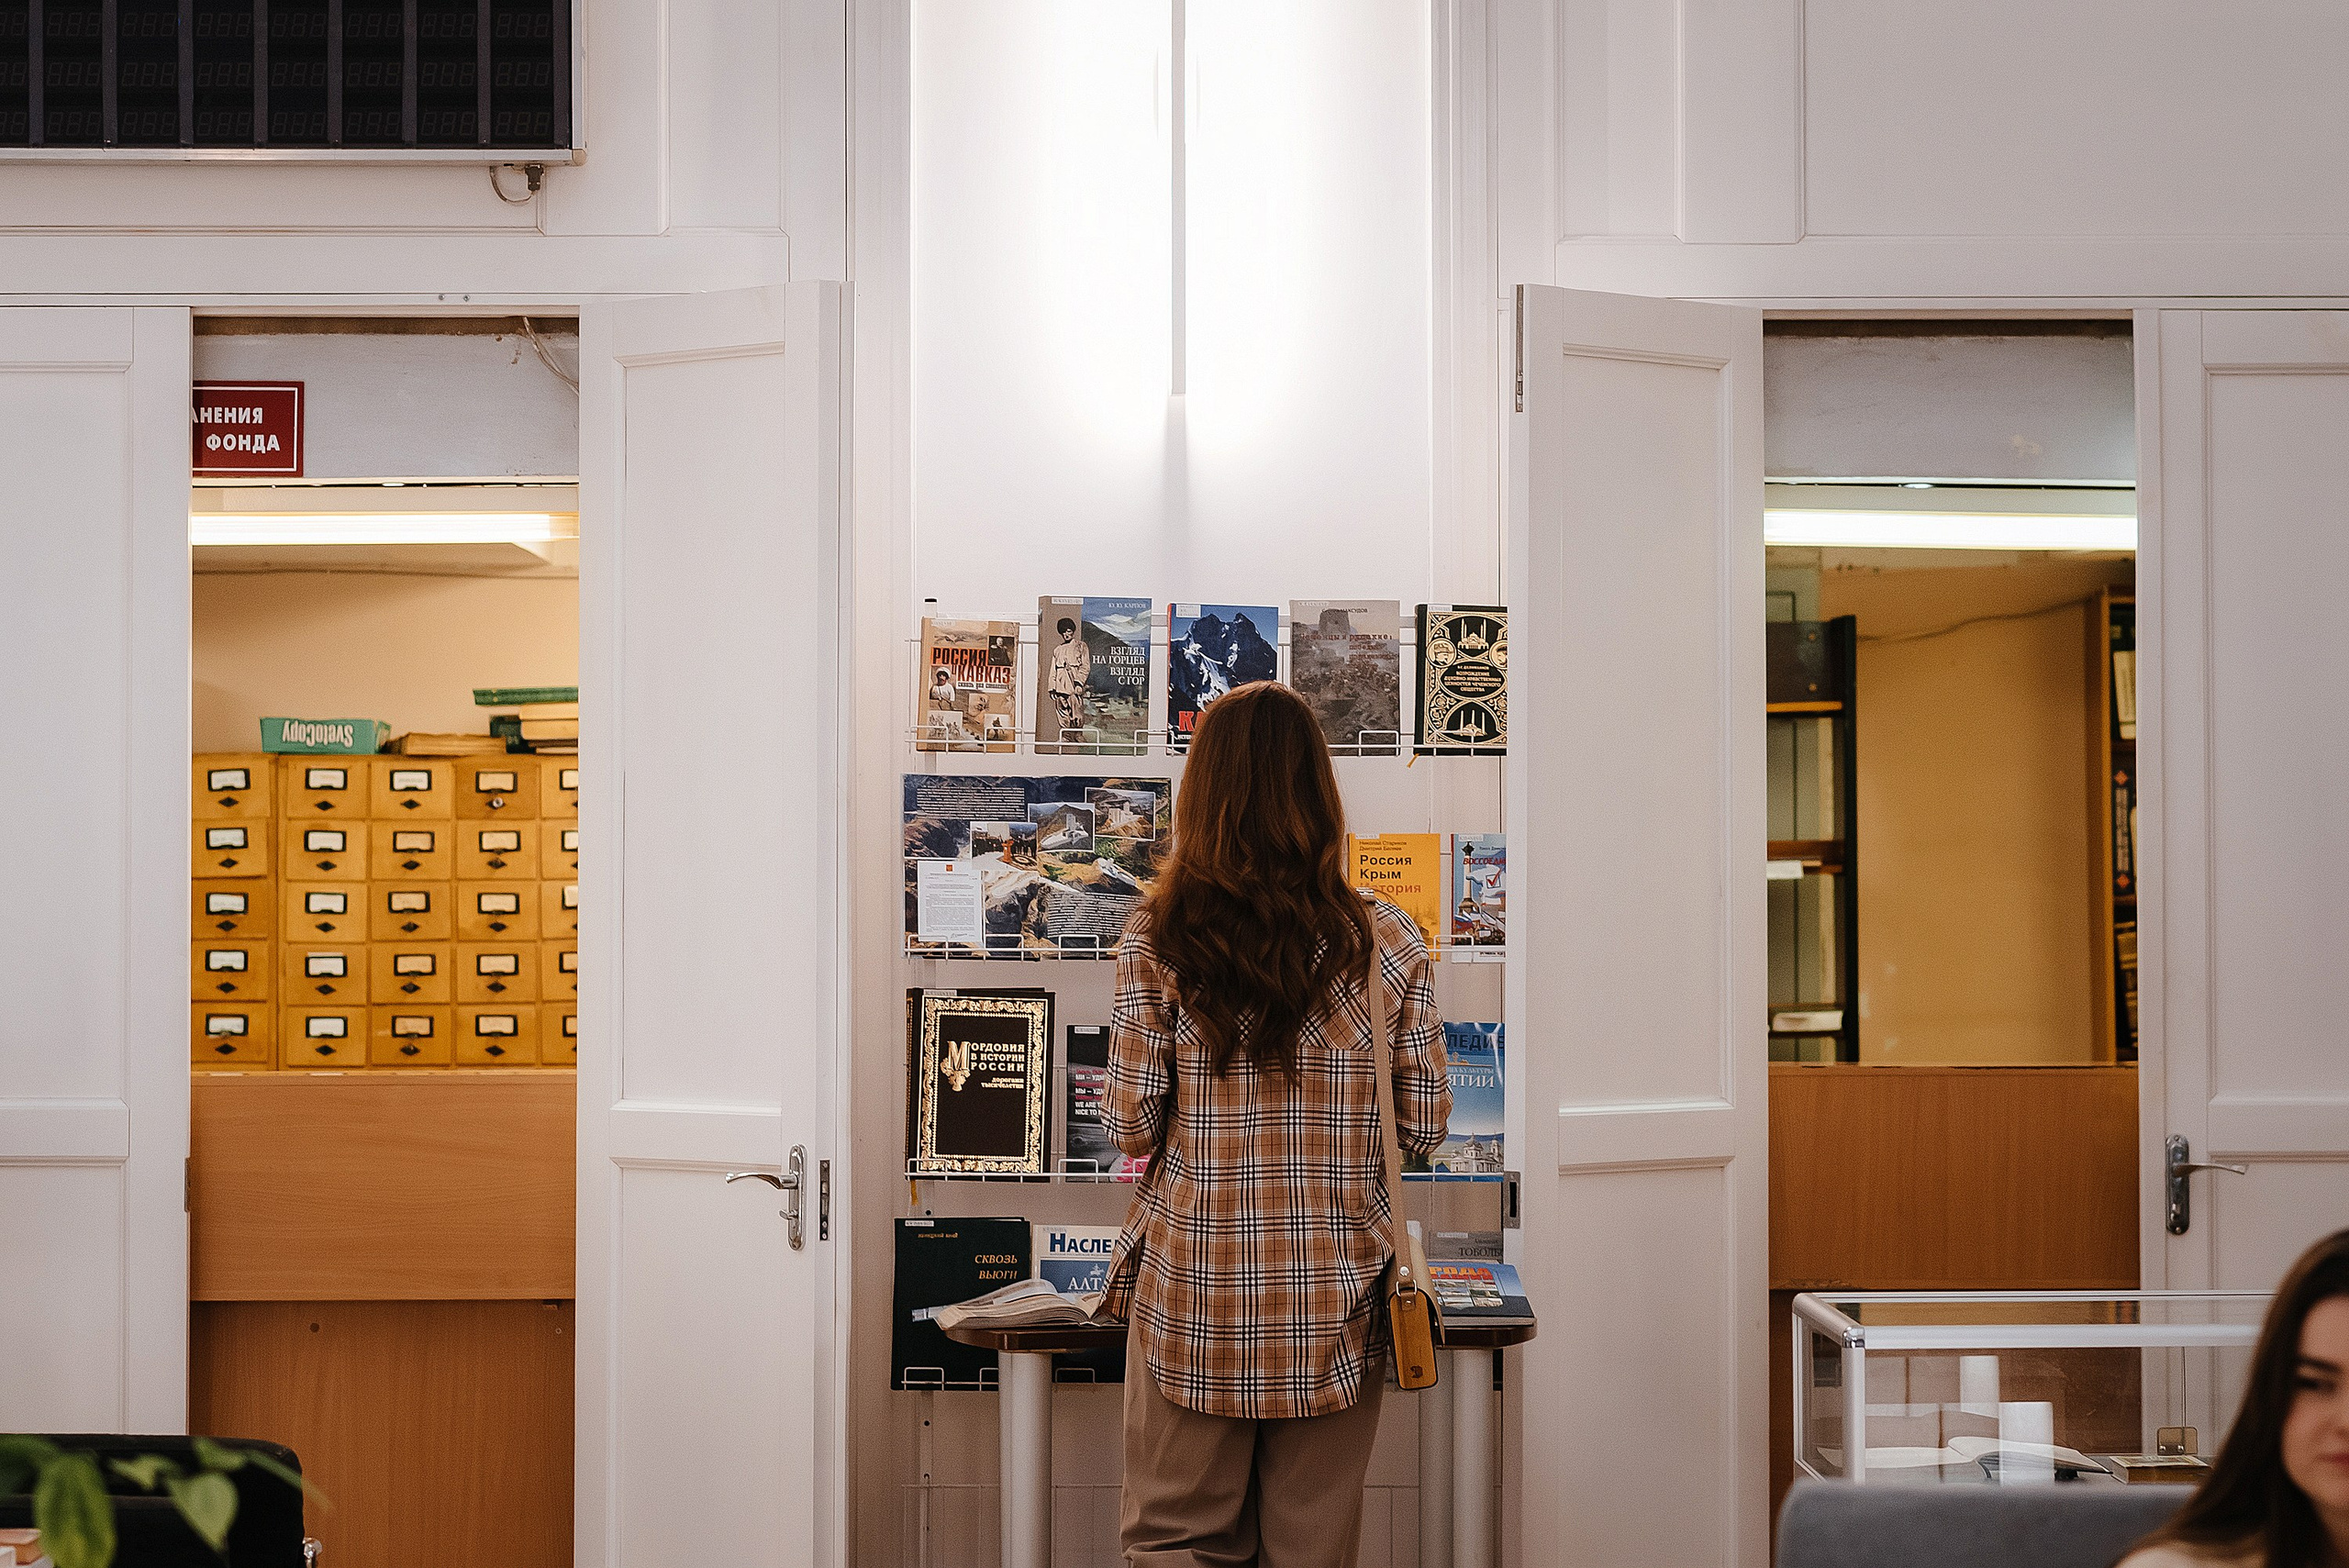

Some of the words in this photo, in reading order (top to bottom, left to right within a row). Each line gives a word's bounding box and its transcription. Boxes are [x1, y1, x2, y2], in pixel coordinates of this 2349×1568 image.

[206, 433, 281, 454] ФОНДА
[1110, 646, 1146, 656] ВЗГЛЯД
[932, 647, 987, 666] РОССИЯ
[1092, 655, 1107, 664] НА
[1108, 655, 1145, 667] ГОРЦЕВ
[957, 664, 1011, 684] КАВКАЗ
[1110, 667, 1145, 677] ВЗГЛЯД
[1118, 676, 1126, 685] С
[1127, 676, 1145, 685] ГОР
[282, 719, 354, 748] SvetoCopy
[1360, 854, 1412, 865] Россия
[1360, 869, 1401, 882] Крым
[980, 1053, 1025, 1062] ИСТОРИИ
[971, 1062, 1025, 1072] РОССИИ
[974, 1254, 1019, 1264] СКВОЗЬ
[978, 1270, 1018, 1280] ВЬЮГИ
